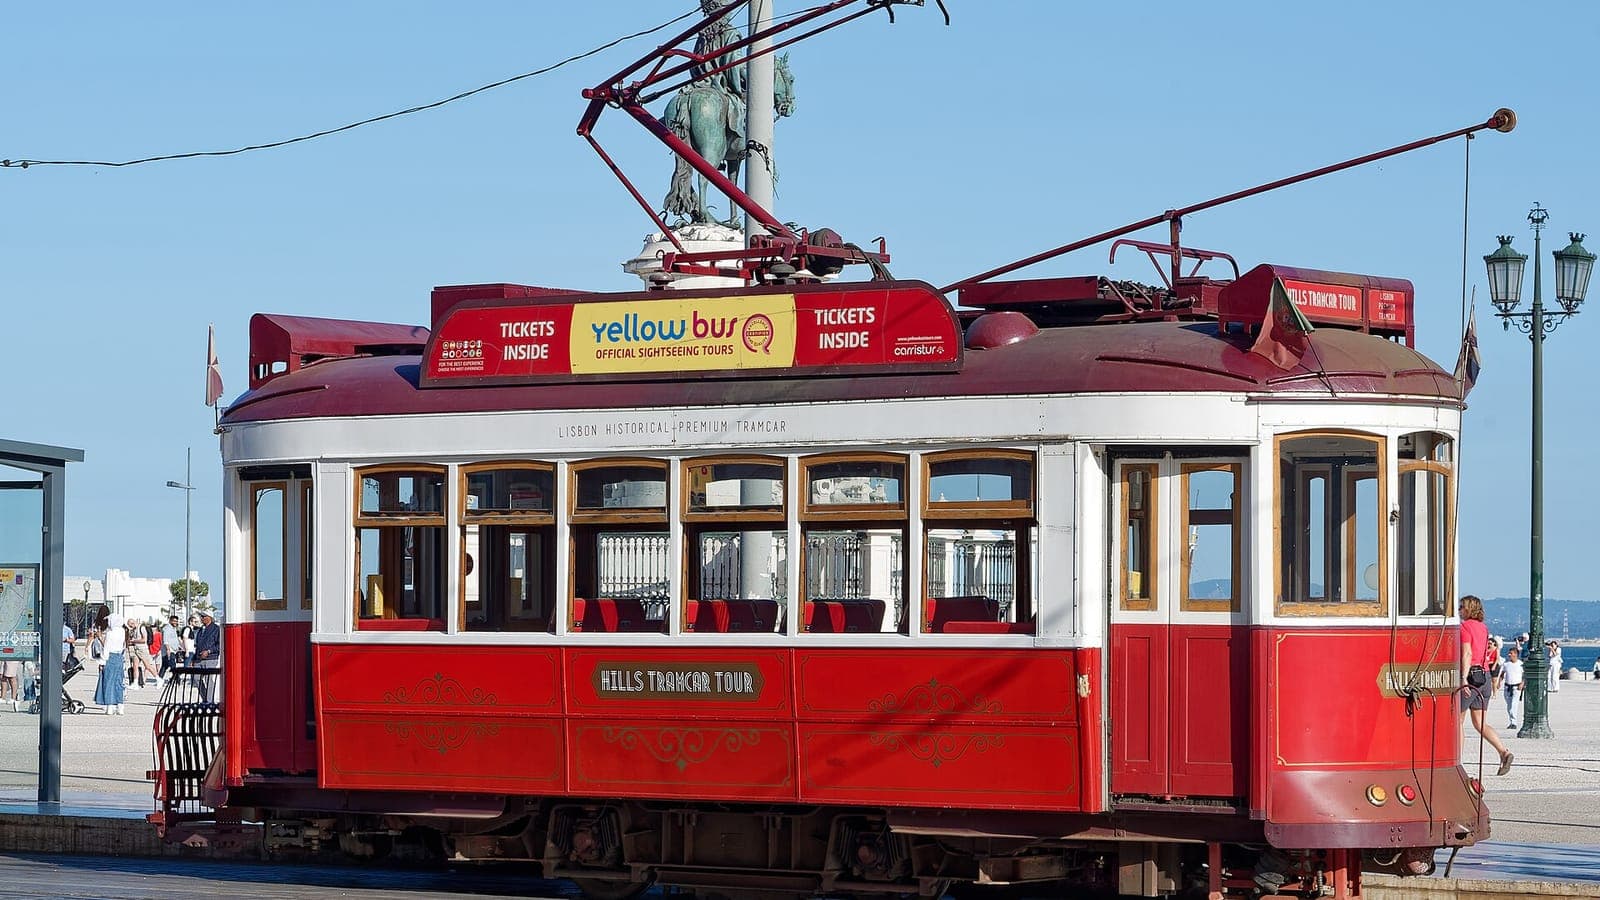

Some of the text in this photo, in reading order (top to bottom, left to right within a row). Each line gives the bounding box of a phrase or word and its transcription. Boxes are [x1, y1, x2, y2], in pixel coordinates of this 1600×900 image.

[1308, 291, 1338, 309] TRAMCAR
[1338, 294, 1357, 311] TOUR
[692, 311, 738, 339] bus
[814, 307, 876, 326] TICKETS
[500, 320, 555, 338] TICKETS
[819, 331, 869, 350] INSIDE
[503, 343, 549, 361] INSIDE
[595, 344, 734, 360] OFFICIAL SIGHTSEEING TOURS
[894, 344, 937, 356] carristur
[558, 420, 787, 438] LISBON HISTORICAL PREMIUM TRAMCAR
[601, 670, 754, 693] HILLS TRAMCAR TOUR
